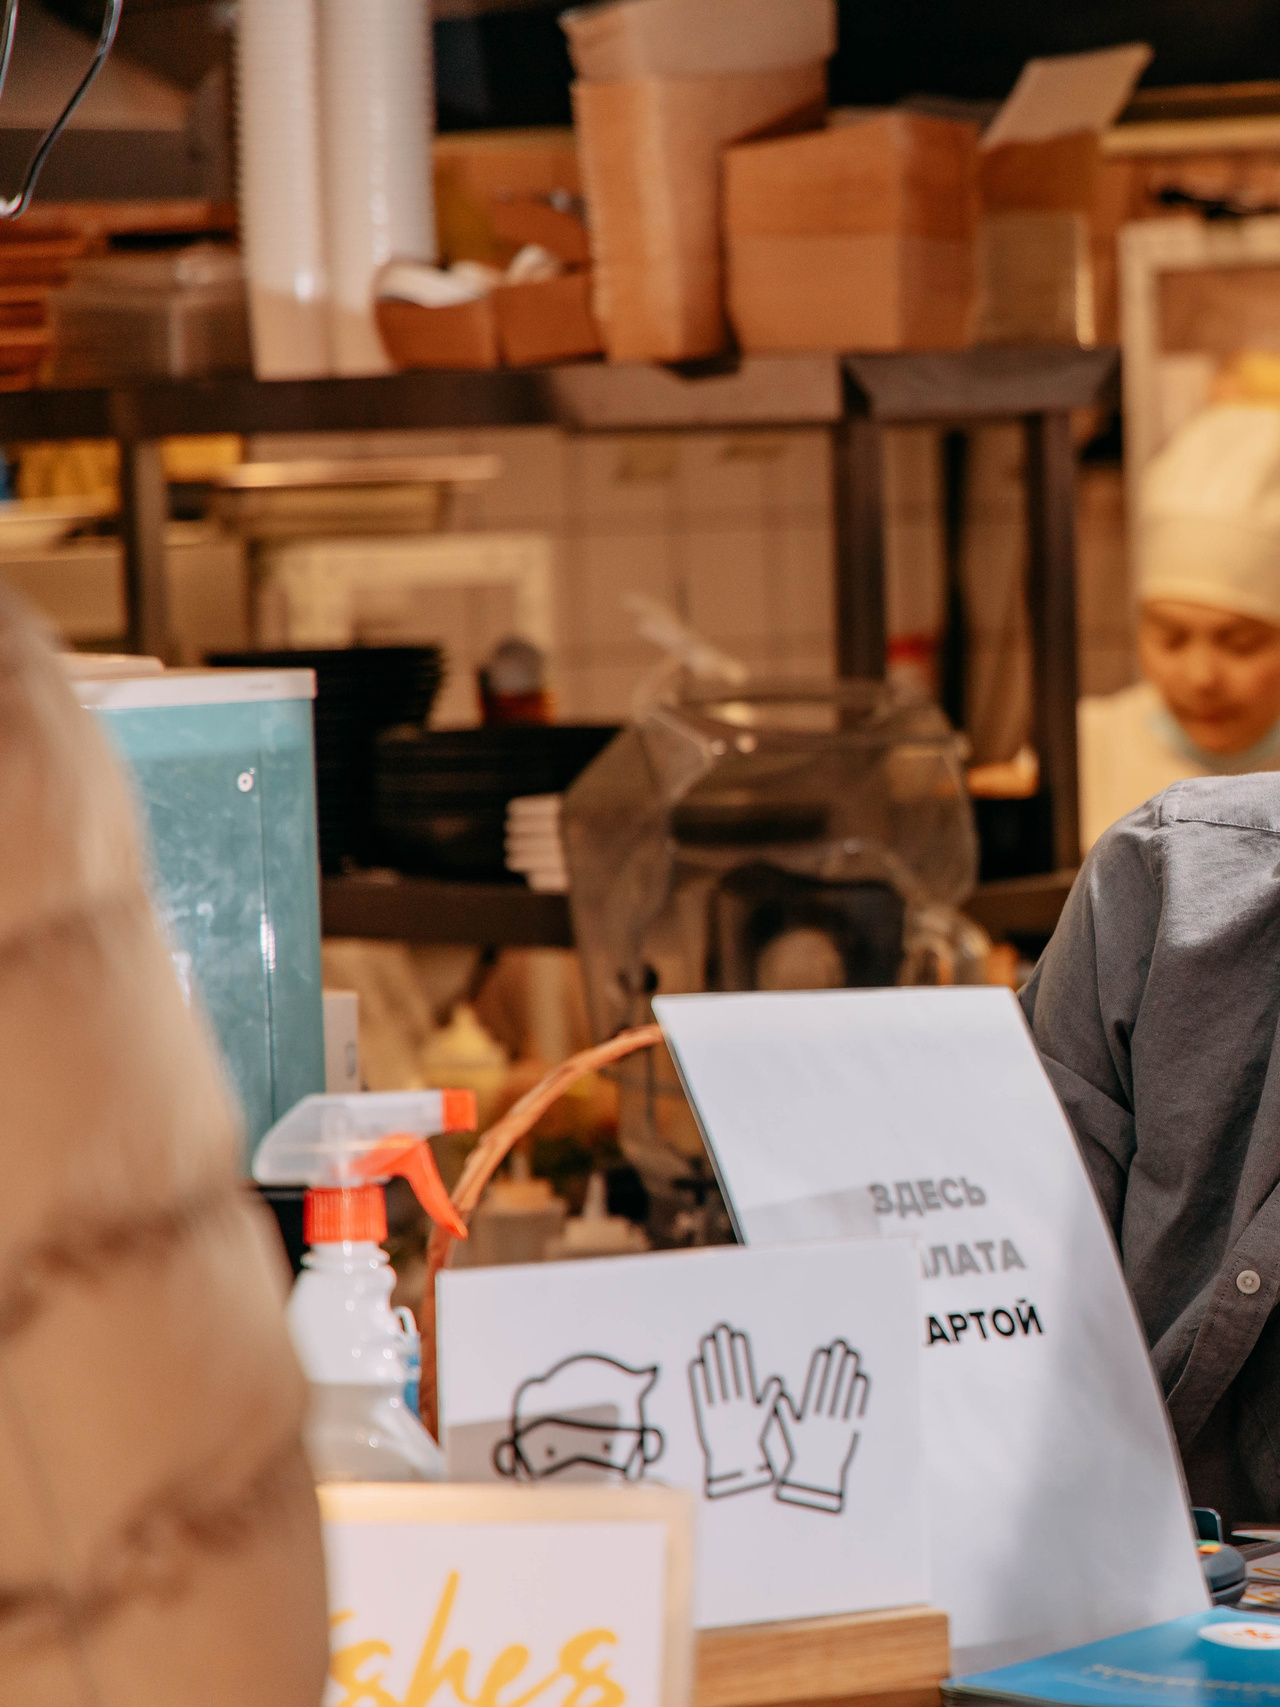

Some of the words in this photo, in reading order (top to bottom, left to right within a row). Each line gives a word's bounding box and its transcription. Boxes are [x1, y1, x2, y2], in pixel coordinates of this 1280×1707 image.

[868, 1177, 986, 1218] ЗДЕСЬ
[922, 1238, 1026, 1278] ЛАТА
[925, 1298, 1043, 1345] АРТОЙ
[329, 1569, 626, 1707] shes
